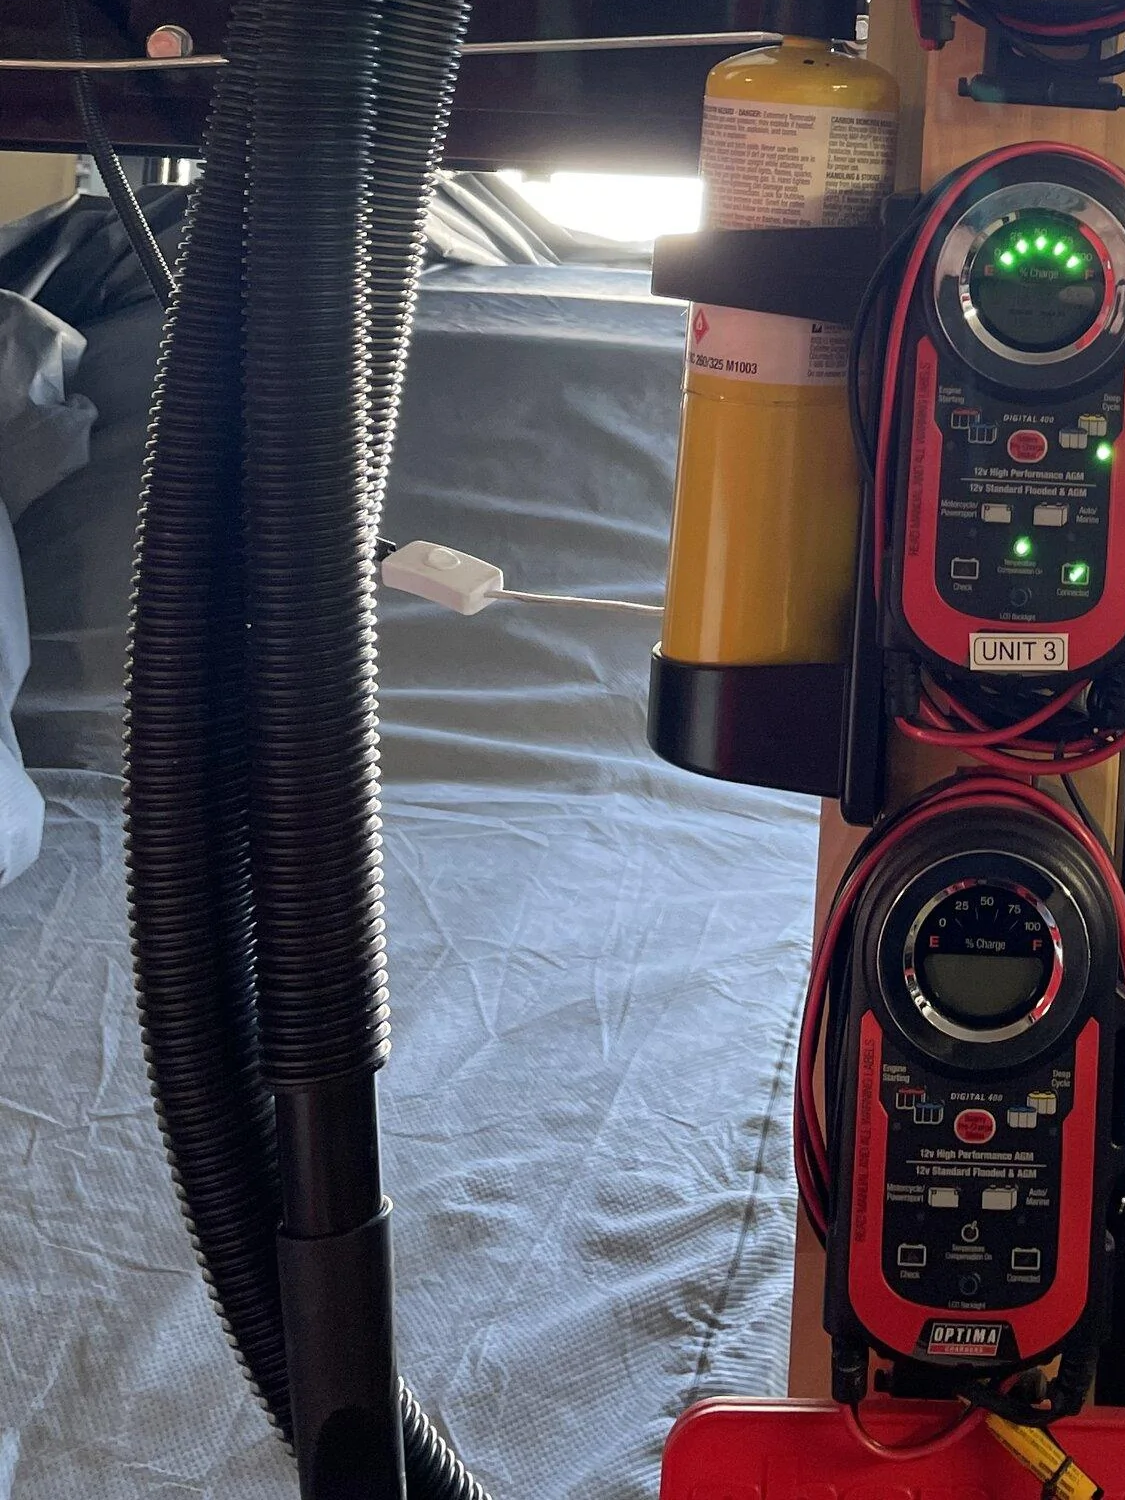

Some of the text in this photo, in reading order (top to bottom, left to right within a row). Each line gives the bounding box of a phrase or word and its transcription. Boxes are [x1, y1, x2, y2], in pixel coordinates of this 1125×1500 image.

[738, 109, 762, 118] DANGER:
[1034, 228, 1047, 236] 50
[984, 265, 994, 276] E
[1019, 267, 1059, 279] % Charge
[1085, 269, 1093, 279] F
[726, 360, 758, 374] M1003
[939, 386, 962, 395] Engine
[939, 394, 965, 404] Starting
[1103, 393, 1121, 403] Deep
[1102, 402, 1120, 412] Cycle
[1003, 414, 1037, 423] DIGITAL
[974, 467, 1084, 481] 12v High Performance AGM
[969, 483, 1087, 497] 12v Standard Flooded & AGM
[941, 508, 978, 518] Powersport
[1079, 506, 1097, 516] Auto/
[1076, 515, 1099, 524] Marine
[953, 583, 972, 591] Check
[1056, 588, 1089, 598] Connected
[982, 641, 1056, 661] UNIT 3
[955, 901, 969, 911] 25
[980, 896, 994, 906] 50
[1008, 905, 1021, 914] 75
[939, 918, 946, 928] 0
[1025, 922, 1041, 931] 100
[929, 936, 939, 947] E
[965, 938, 1006, 950] % Charge
[1033, 940, 1042, 950] F
[883, 1064, 907, 1074] Engine
[1052, 1069, 1071, 1079] Deep
[882, 1073, 910, 1083] Starting
[1052, 1078, 1070, 1088] Cycle
[950, 1092, 1003, 1102] DIGITAL 400
[920, 1148, 1034, 1161] 12v High Performance AGM
[916, 1166, 1037, 1179] 12v Standard Flooded & AGM
[1029, 1188, 1048, 1197] Auto/
[1026, 1196, 1050, 1206] Marine
[933, 1326, 998, 1344] OPTIMA
